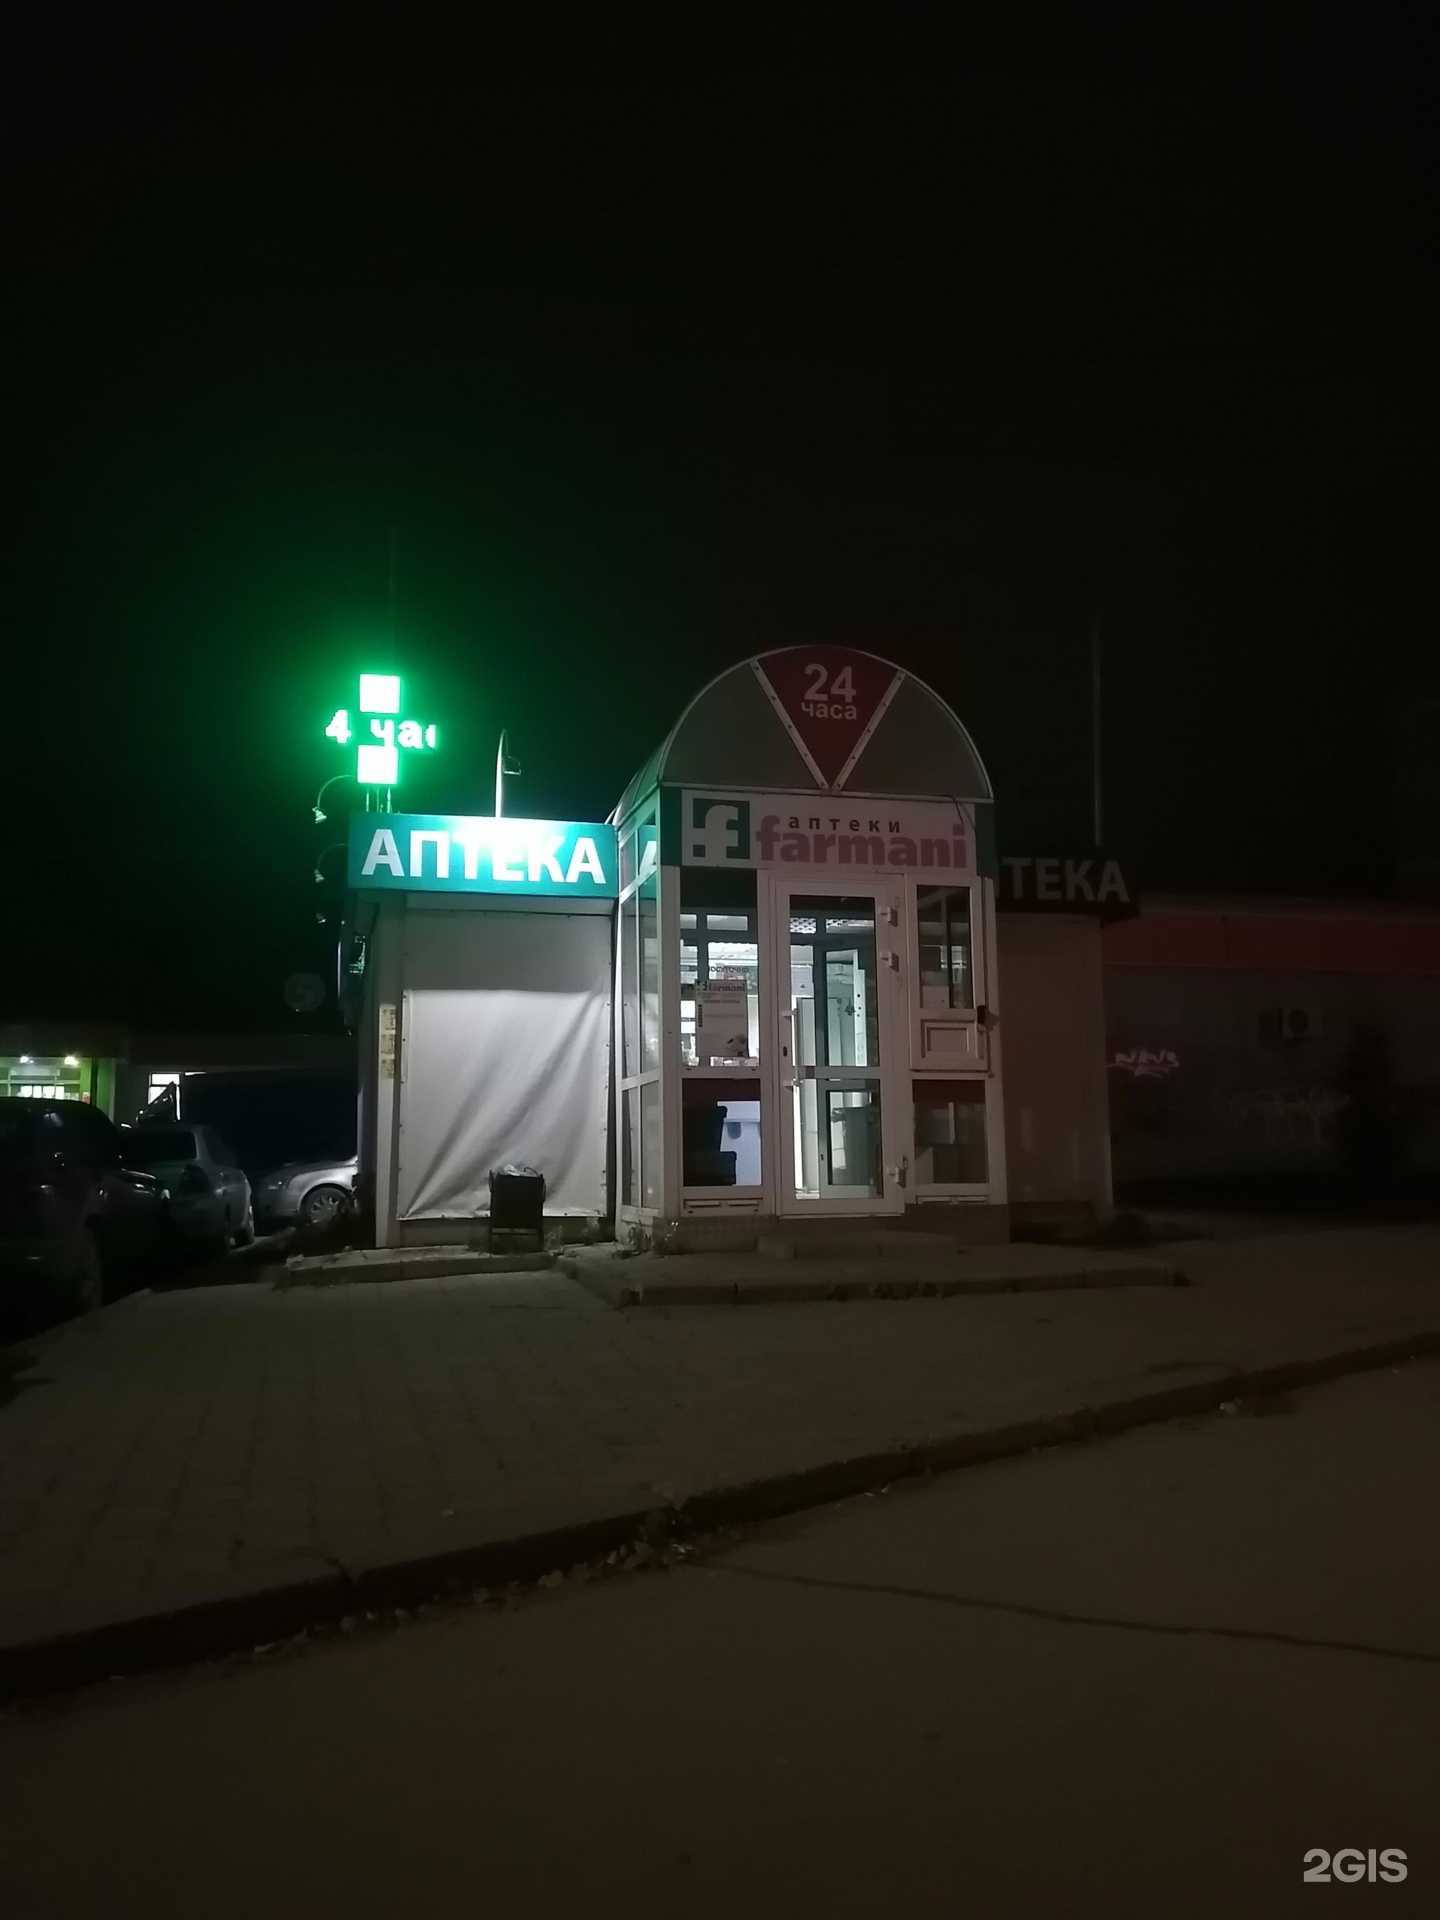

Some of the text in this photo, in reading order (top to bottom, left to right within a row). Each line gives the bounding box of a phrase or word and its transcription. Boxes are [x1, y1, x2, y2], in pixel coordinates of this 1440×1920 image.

[803, 663, 857, 703] 24
[801, 701, 857, 720] часа
[756, 815, 969, 868] farmani
[788, 814, 902, 834] аптеки
[361, 828, 607, 885] АПТЕКА
[995, 856, 1131, 903] ТЕКА
